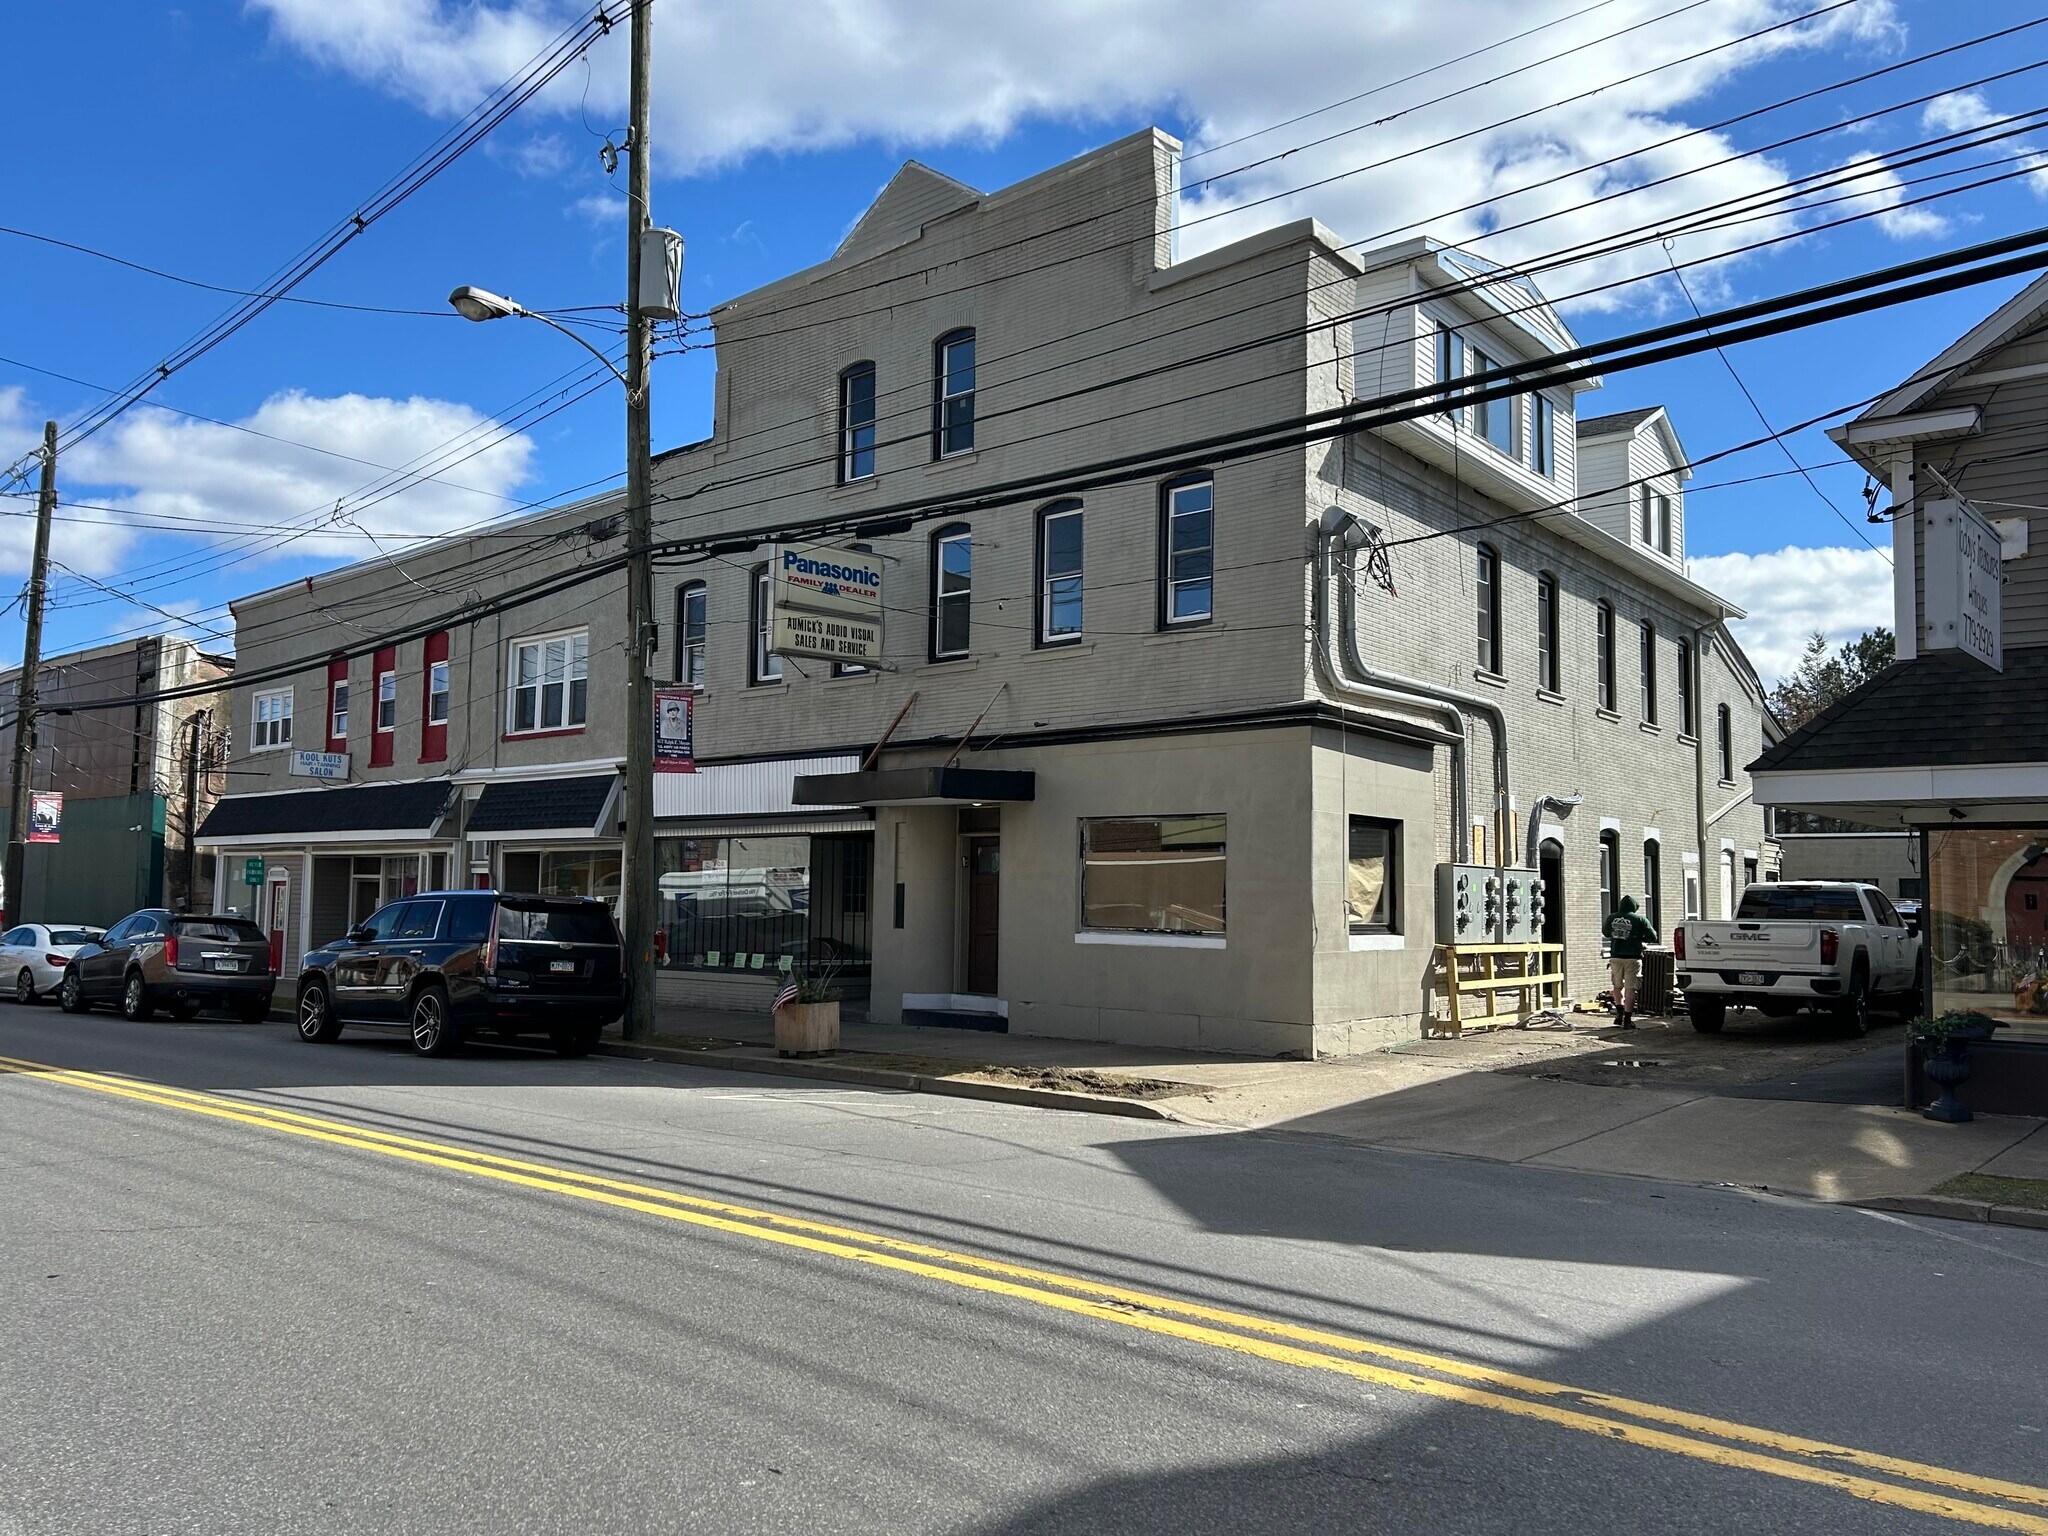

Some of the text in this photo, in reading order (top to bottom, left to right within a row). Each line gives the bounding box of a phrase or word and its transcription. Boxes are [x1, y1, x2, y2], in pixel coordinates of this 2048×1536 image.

[783, 550, 880, 587] Panasonic
[787, 575, 877, 598] FAMILY DEALER
[787, 616, 875, 642] AUMICK'S AUDIO VISUAL
[794, 633, 867, 656] SALES AND SERVICE
[300, 752, 342, 763] KOOL KUTS
[309, 767, 334, 776] SALON
[1730, 932, 1770, 940] GMC
